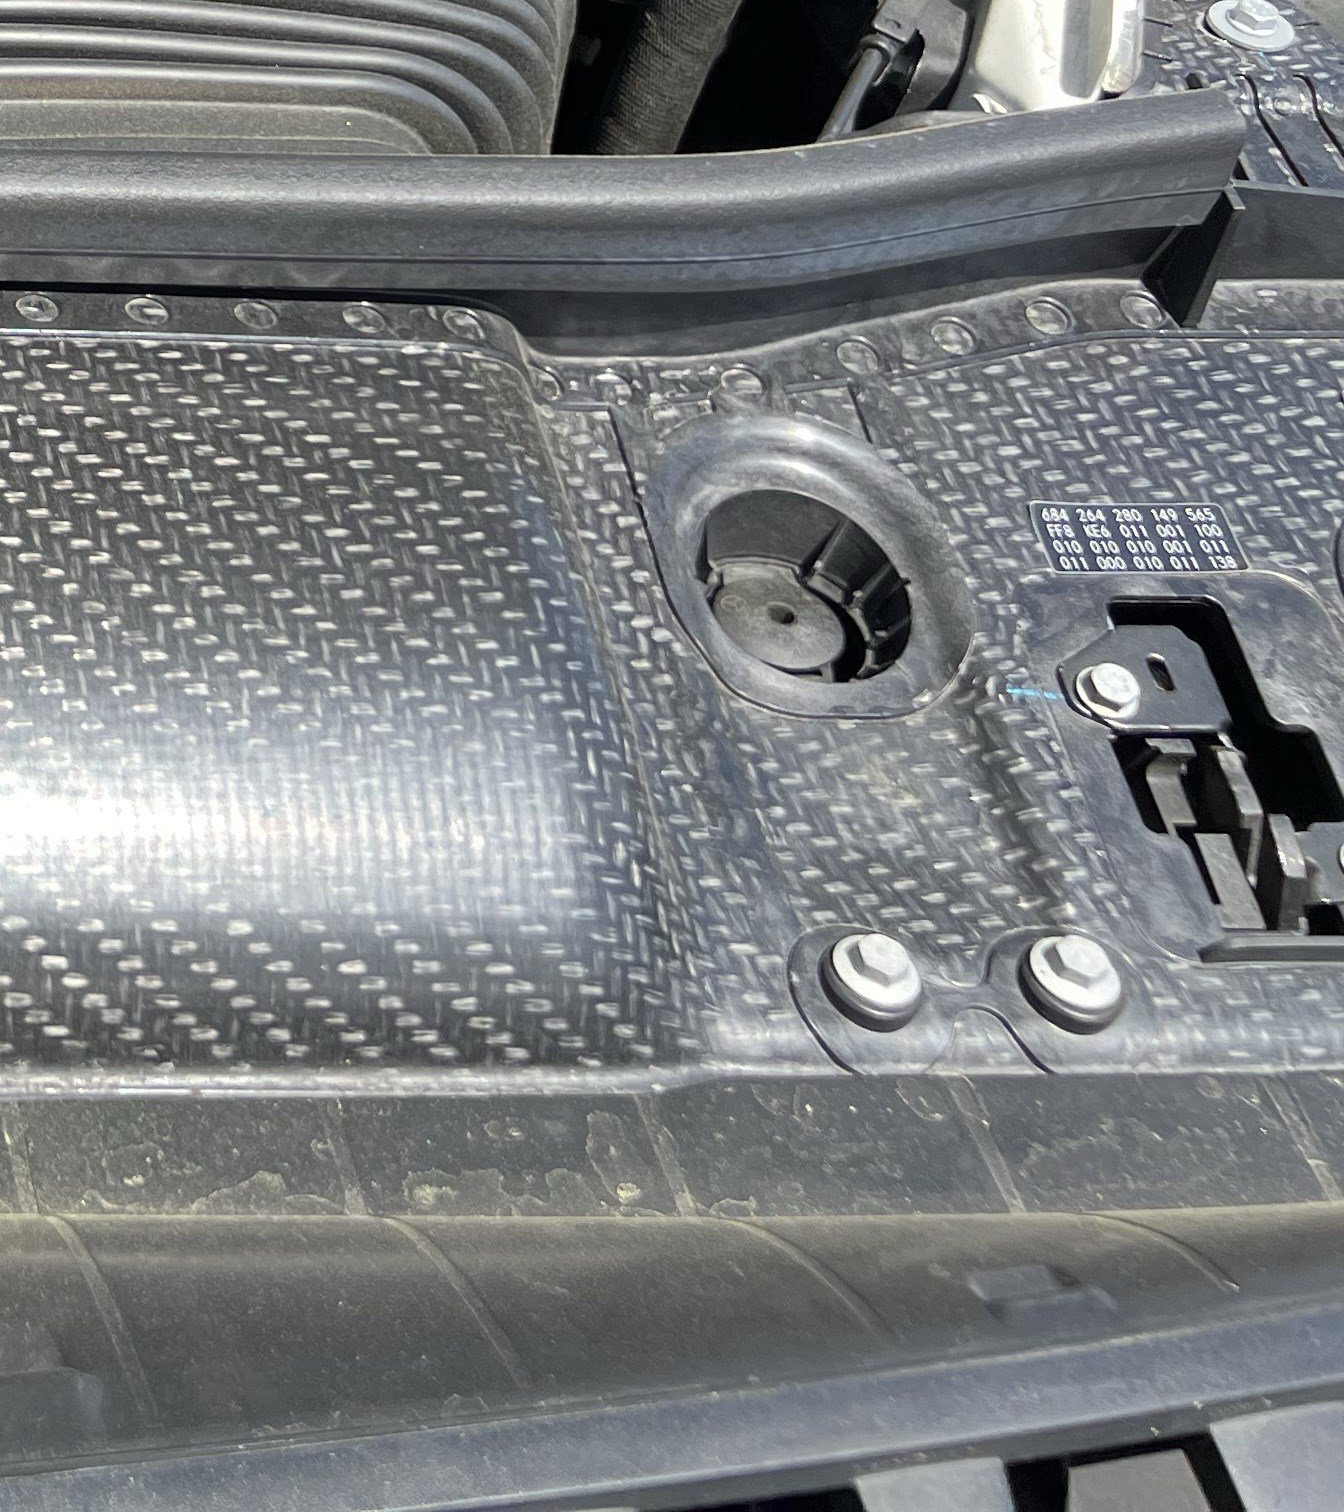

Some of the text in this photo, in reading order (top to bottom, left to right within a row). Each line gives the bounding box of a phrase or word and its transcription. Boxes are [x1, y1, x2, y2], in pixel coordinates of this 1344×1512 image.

[1041, 507, 1215, 523] 684 264 280 149 565
[1119, 523, 1149, 538] 011
[1155, 523, 1185, 538] 001
[1193, 523, 1224, 538] 100
[1052, 539, 1229, 554] 010 010 010 001 011
[1059, 555, 1089, 571] 011
[1096, 555, 1127, 571] 000
[1133, 555, 1163, 571] 010
[1169, 555, 1200, 571] 011
